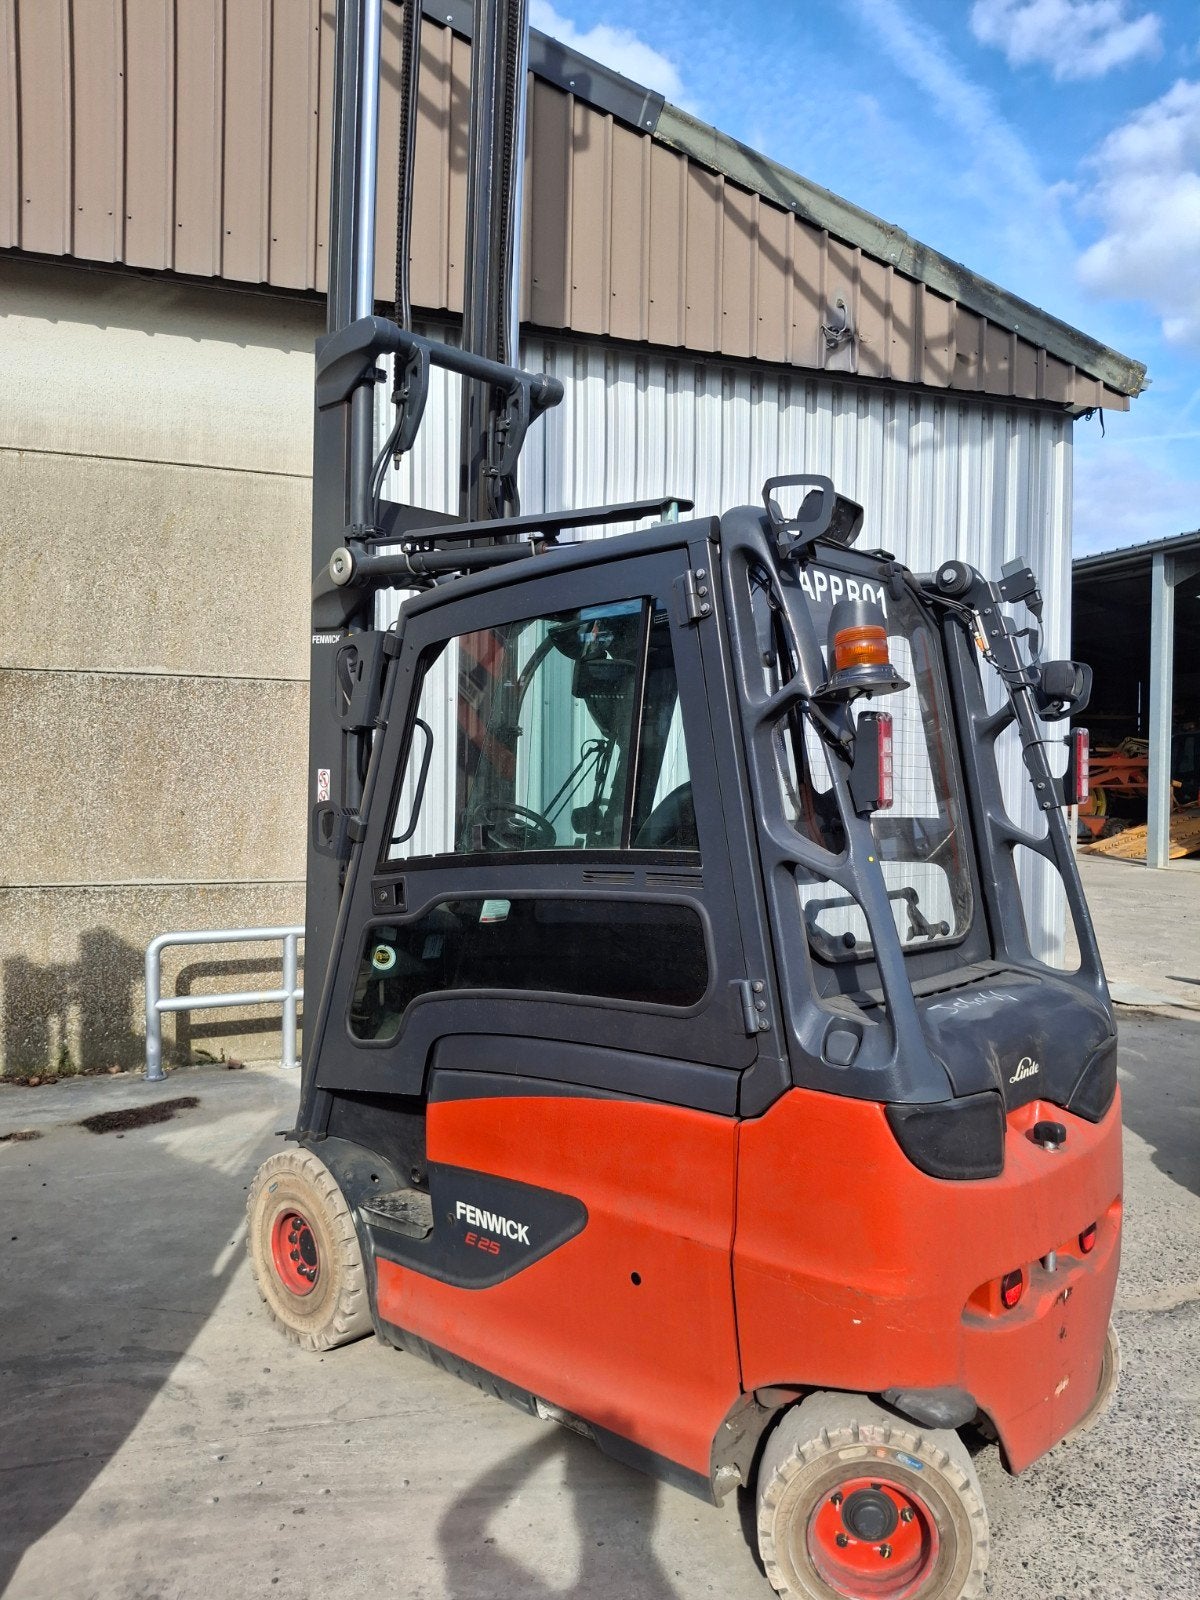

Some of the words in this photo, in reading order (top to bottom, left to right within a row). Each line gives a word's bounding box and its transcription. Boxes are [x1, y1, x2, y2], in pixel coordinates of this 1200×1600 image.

[312, 634, 341, 644] FENWICK
[1009, 1056, 1040, 1084] Linde
[456, 1200, 531, 1246] FENWICK
[464, 1231, 478, 1246] E
[478, 1236, 501, 1255] 25
